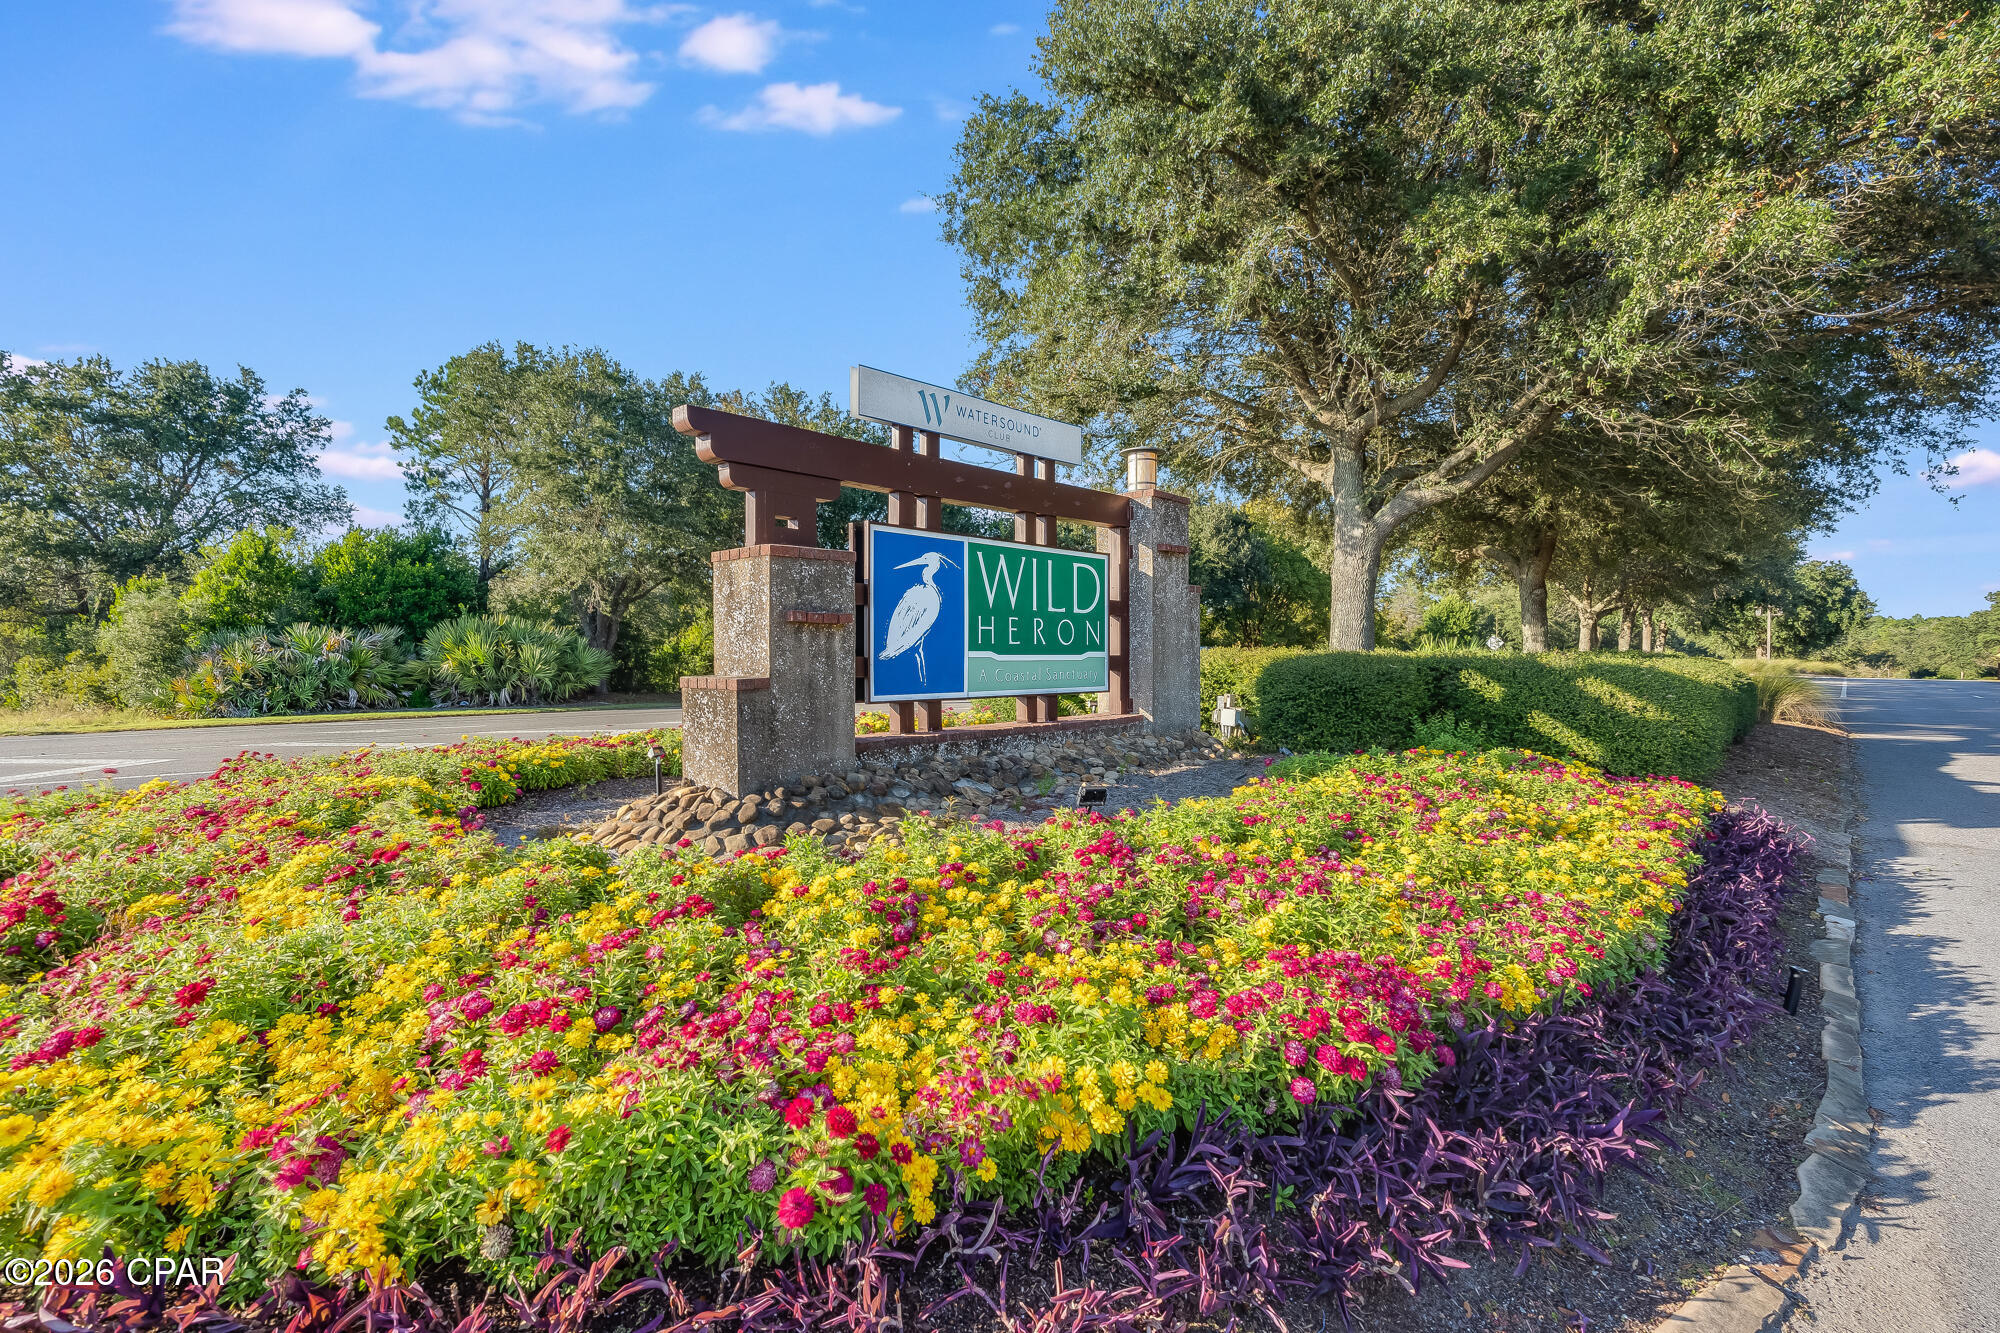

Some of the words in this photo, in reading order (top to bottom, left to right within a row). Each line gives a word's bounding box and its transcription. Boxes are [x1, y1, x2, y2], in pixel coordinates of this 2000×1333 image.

[987, 429, 1011, 442] CLUB
[977, 551, 1100, 614] WILD
[977, 615, 1100, 646] HERON
[979, 668, 988, 682] A
[995, 668, 1042, 683] Coastal
[1045, 668, 1098, 684] Sanctuary
